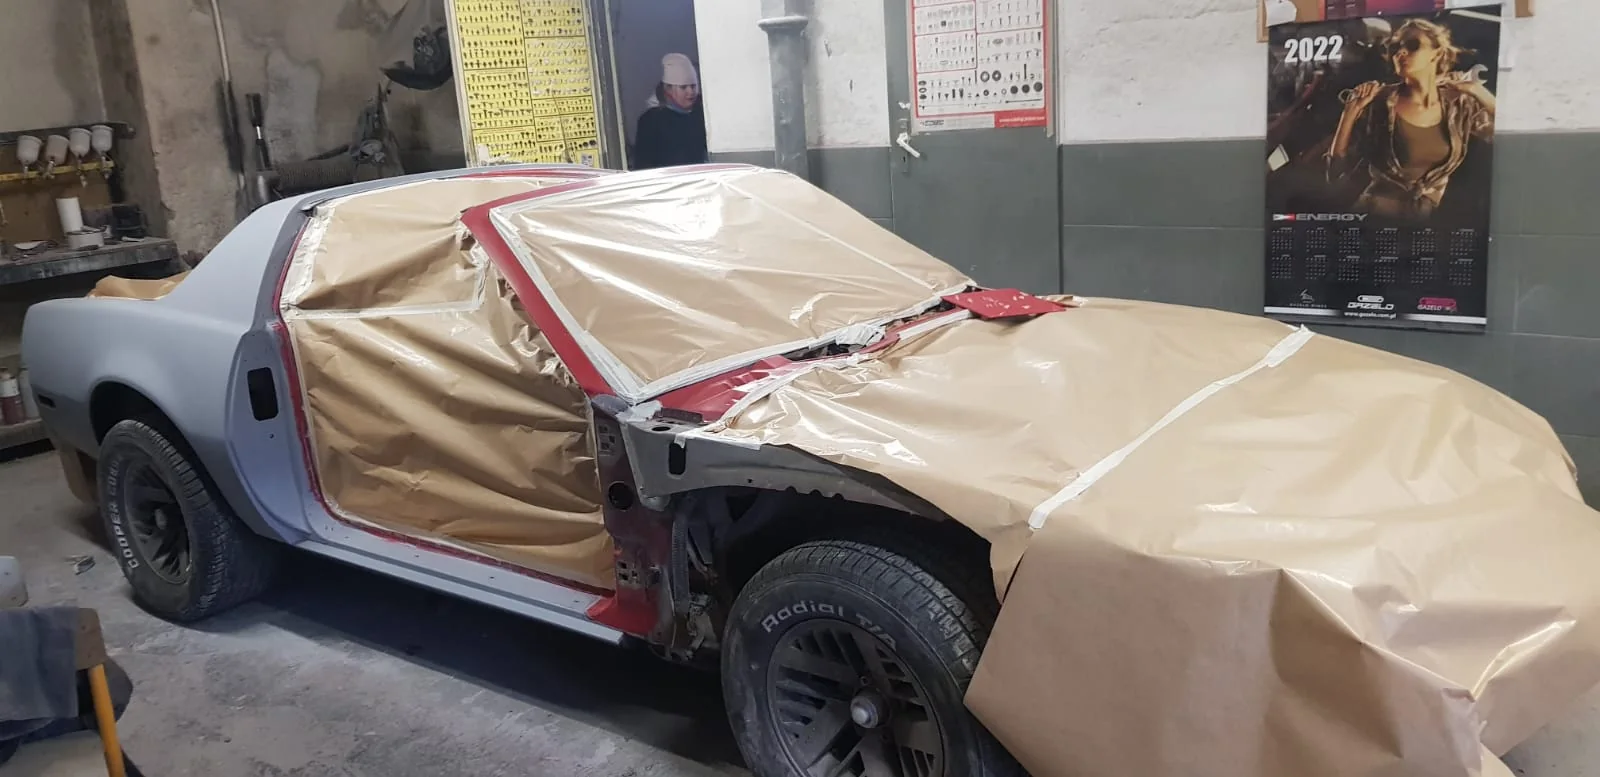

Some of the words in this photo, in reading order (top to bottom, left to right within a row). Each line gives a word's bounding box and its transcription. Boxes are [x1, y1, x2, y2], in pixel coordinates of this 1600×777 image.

[1284, 34, 1344, 63] 2022
[1296, 213, 1369, 221] ENERGY
[108, 502, 140, 569] COOPER
[761, 599, 844, 633] Radial
